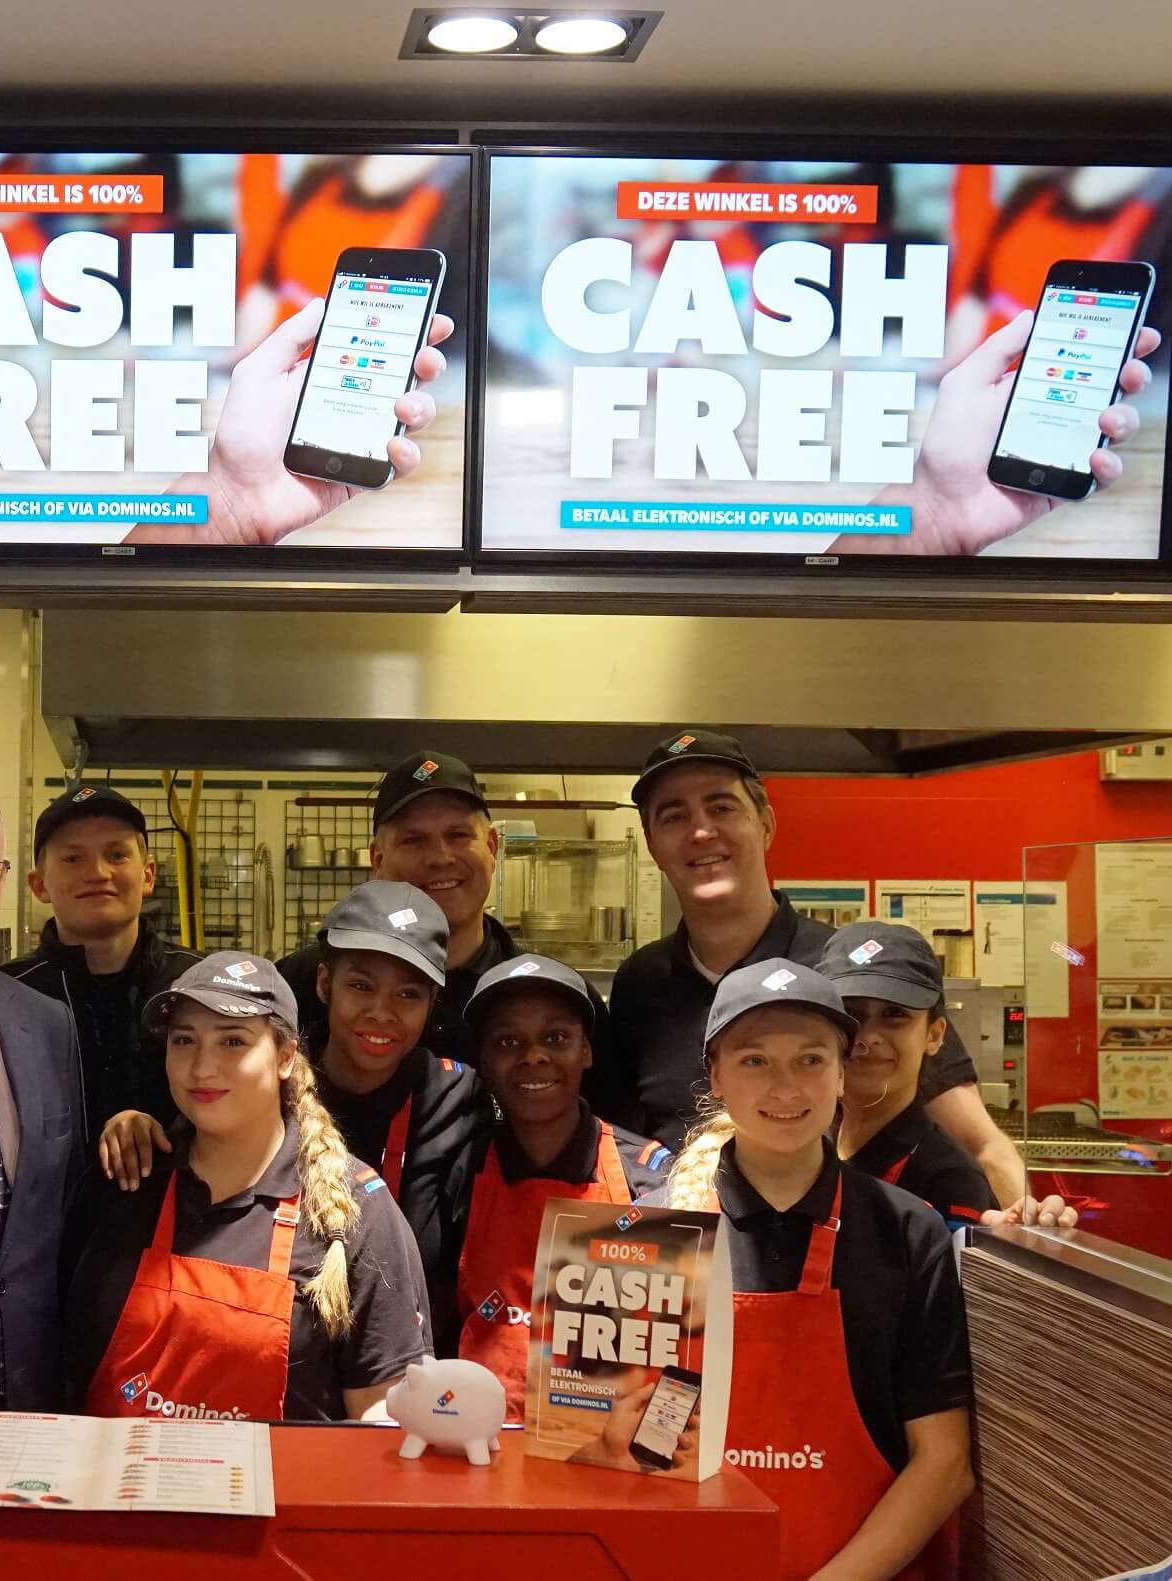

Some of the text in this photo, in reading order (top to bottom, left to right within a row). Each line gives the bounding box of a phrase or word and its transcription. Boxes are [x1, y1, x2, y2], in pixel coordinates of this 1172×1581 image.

[64, 185, 83, 204] IS
[88, 185, 143, 204] 100%
[638, 191, 857, 215] DEZE WINKEL IS 100%
[541, 237, 949, 358] CASH
[570, 366, 916, 483] FREE
[44, 501, 64, 516] OF
[68, 501, 94, 516] VIA
[97, 502, 195, 517] DOMINOS.NL
[572, 508, 899, 527] BETAAL ELEKTRONISCH OF VIA DOMINOS.NL
[599, 1243, 646, 1262] 100%
[555, 1264, 685, 1316] CASH
[552, 1310, 681, 1369] FREE
[550, 1367, 584, 1380] BETAAL
[550, 1378, 617, 1396] ELEKTRONISCH
[724, 1444, 826, 1469] omino's
